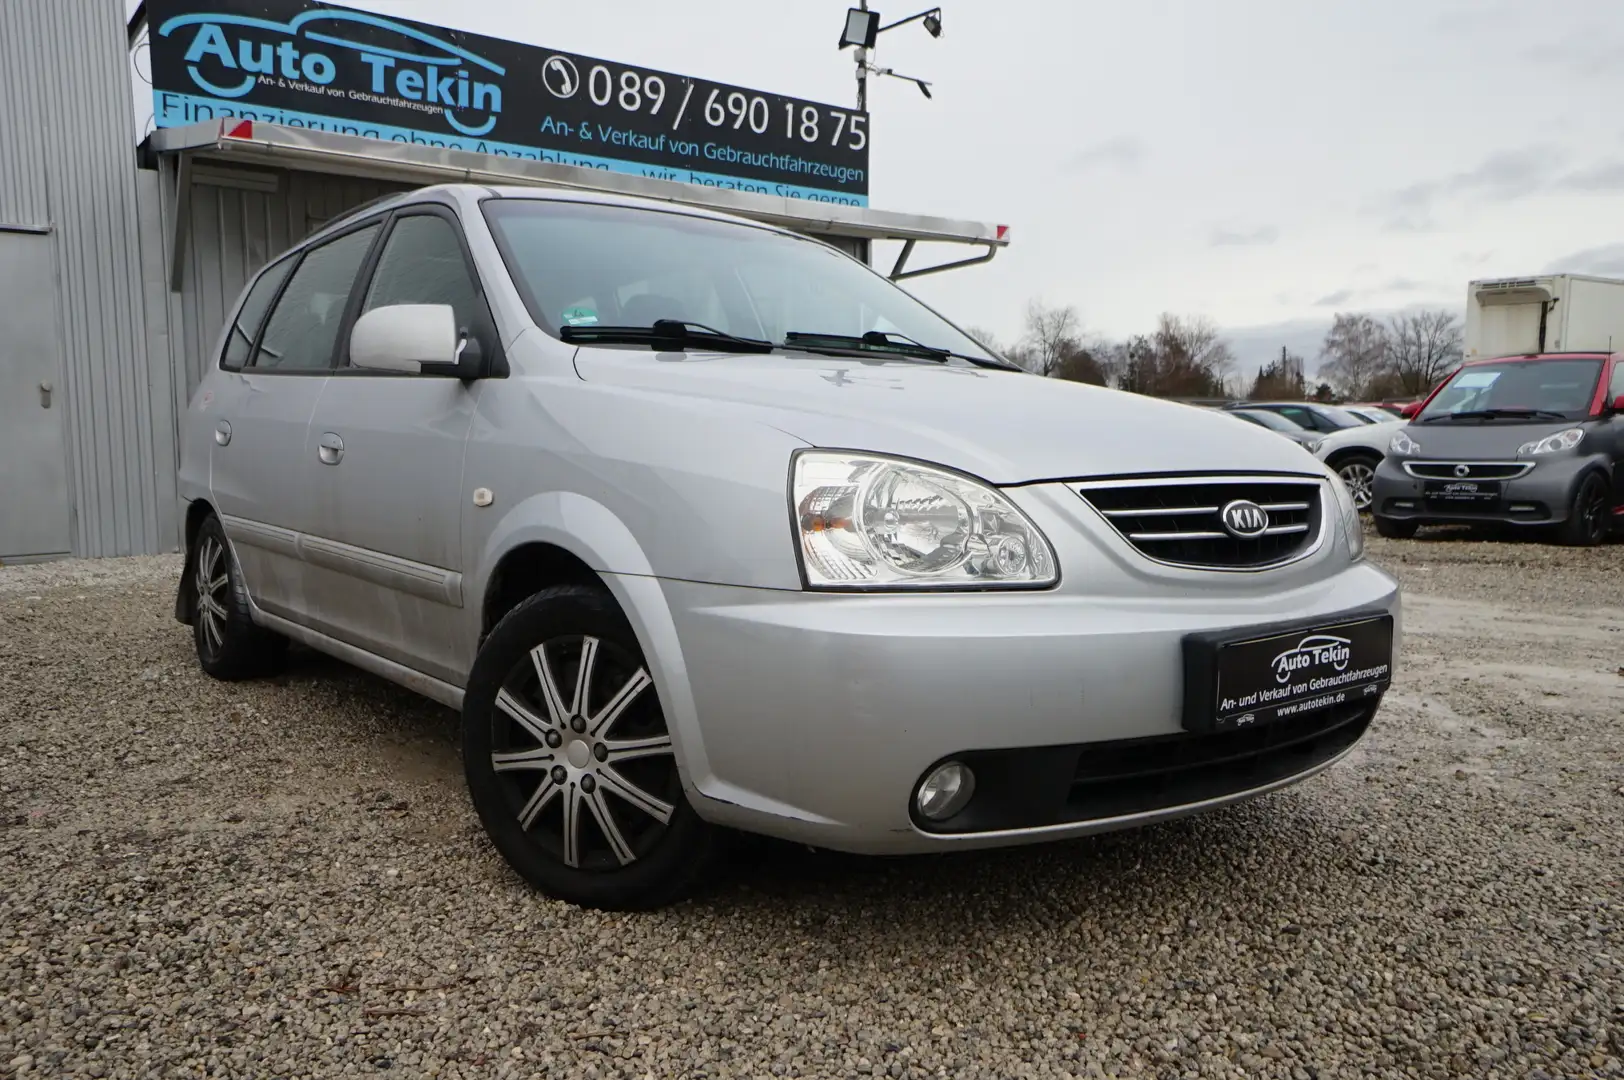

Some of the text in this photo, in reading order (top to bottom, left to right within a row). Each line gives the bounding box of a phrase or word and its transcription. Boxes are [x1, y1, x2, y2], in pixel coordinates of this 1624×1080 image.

[184, 23, 502, 113] Auto Tekin
[257, 75, 443, 116] An- & Verkauf von Gebrauchtfahrzeugen
[588, 65, 666, 116] 089
[704, 88, 769, 135] 690
[785, 103, 819, 143] 18
[829, 111, 867, 151] 75
[541, 115, 864, 184] An- & Verkauf von Gebrauchtfahrzeugen
[1231, 508, 1264, 529] KIA
[1277, 645, 1350, 674] Auto Tekin
[1220, 697, 1237, 711] An-
[1239, 692, 1257, 707] und
[1258, 684, 1292, 704] Verkauf
[1292, 683, 1308, 696] von
[1309, 664, 1388, 691] Gebrauchtfahrzeugen
[1276, 692, 1346, 717] www.autotekin.de
